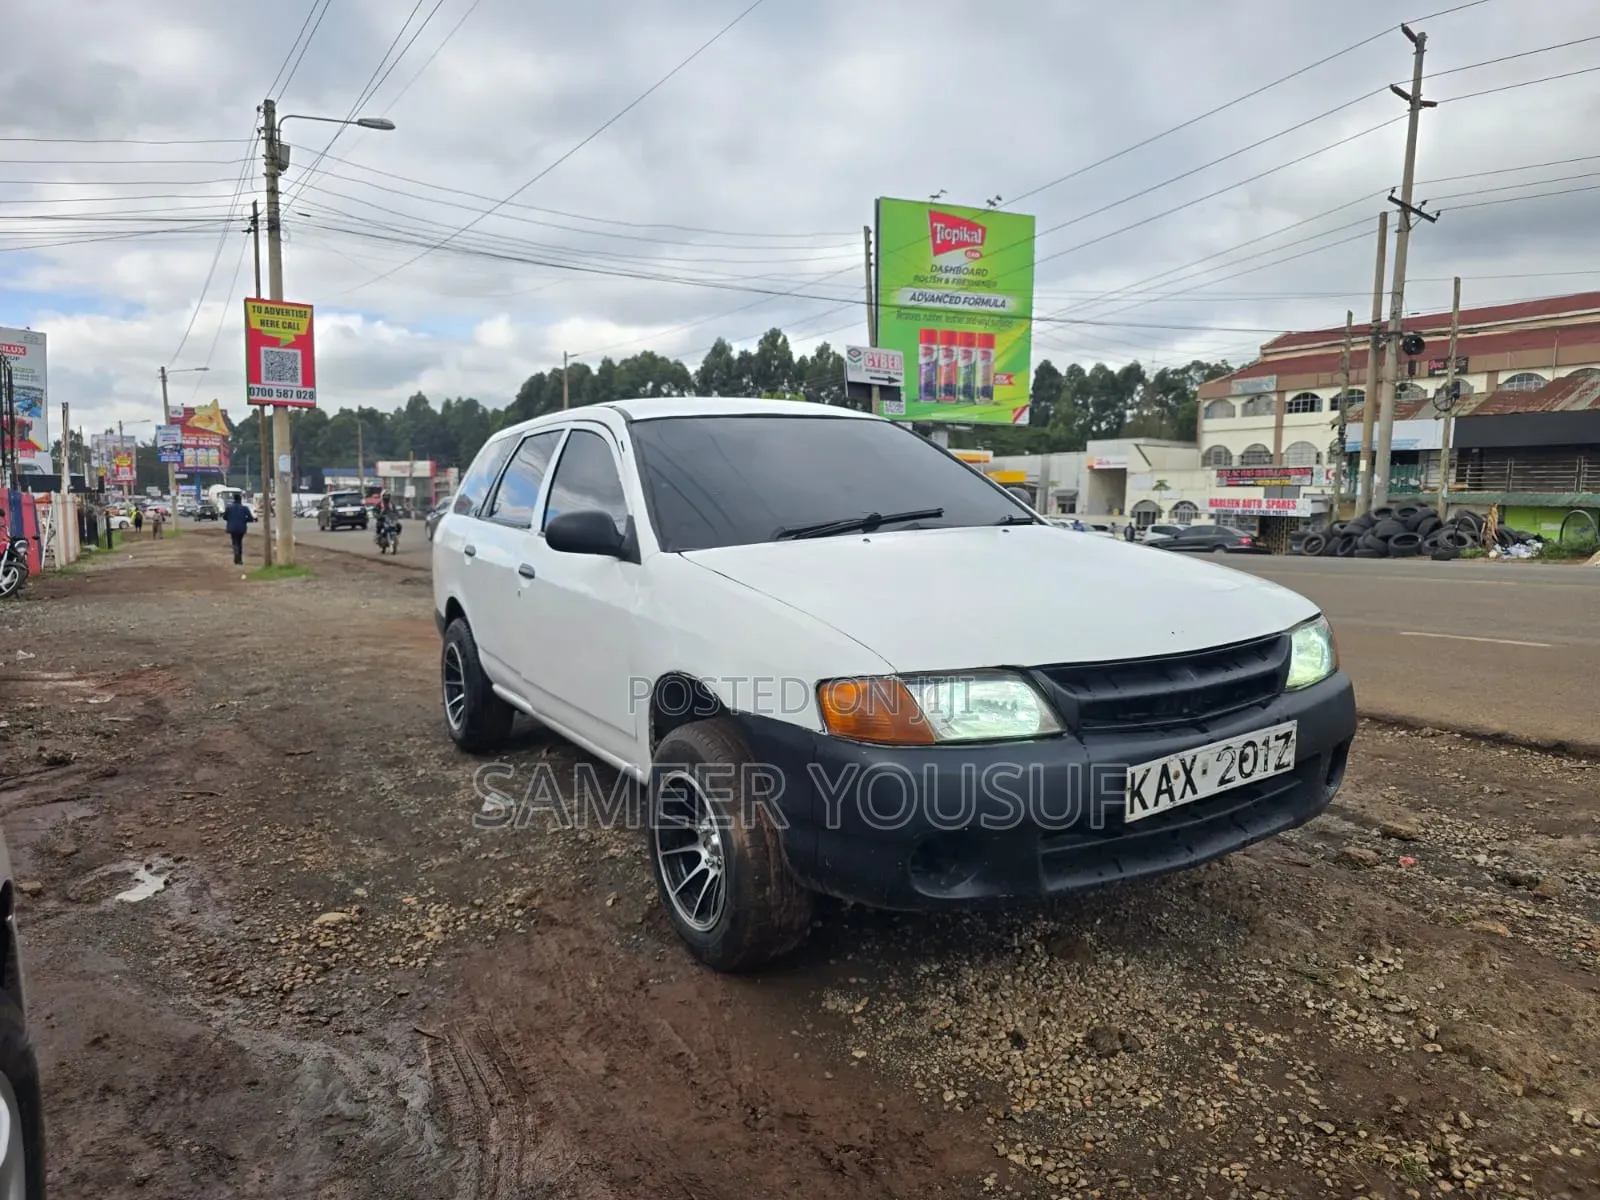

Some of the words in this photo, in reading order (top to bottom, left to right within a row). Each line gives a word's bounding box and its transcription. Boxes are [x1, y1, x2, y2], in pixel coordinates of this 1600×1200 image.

[933, 222, 982, 245] Tropikal
[930, 263, 989, 278] DASHBOARD
[909, 291, 962, 306] ADVANCED
[962, 295, 1007, 309] FORMULA
[252, 304, 262, 314] TO
[264, 306, 308, 319] ADVERTISE
[260, 319, 280, 329] HERE
[281, 320, 300, 331] CALL
[863, 351, 903, 371] CYBER
[249, 386, 274, 399] 0700
[276, 388, 294, 399] 587
[296, 389, 314, 401] 028
[1242, 498, 1263, 509] AUTO
[1266, 499, 1297, 510] SPARES
[1129, 755, 1199, 815] KAX
